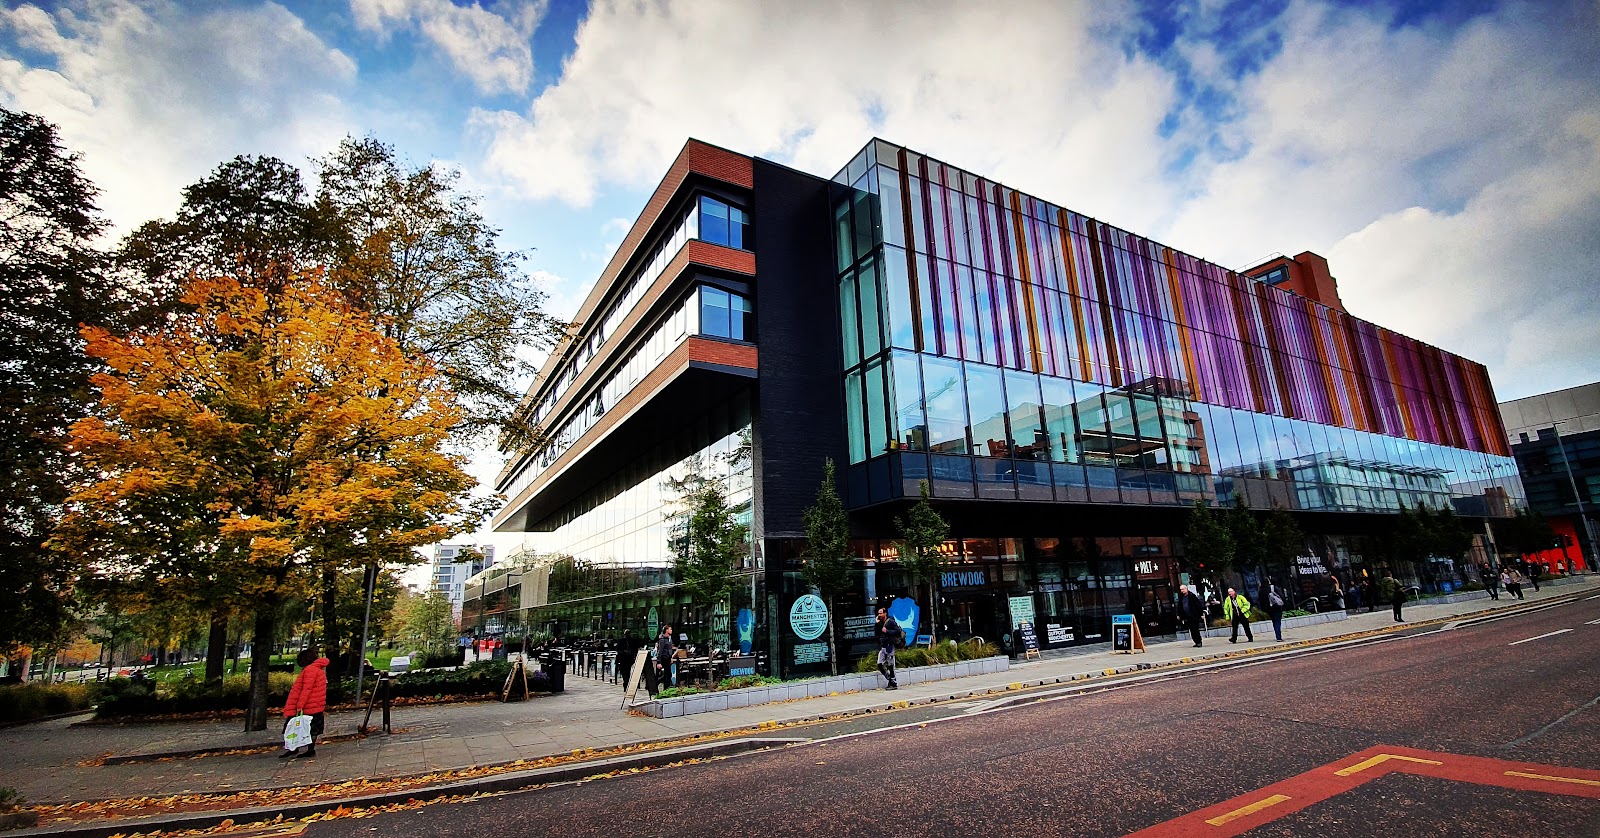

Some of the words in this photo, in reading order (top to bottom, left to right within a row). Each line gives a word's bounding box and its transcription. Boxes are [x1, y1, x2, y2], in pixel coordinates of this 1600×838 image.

[1297, 555, 1310, 566] Bring
[1298, 566, 1312, 575] ideas
[1312, 566, 1318, 574] to
[942, 571, 985, 587] BREWDOG
[714, 602, 728, 615] ALL
[714, 617, 728, 631] DAY
[713, 633, 728, 642] WORK
[731, 667, 755, 676] BREWDOG
